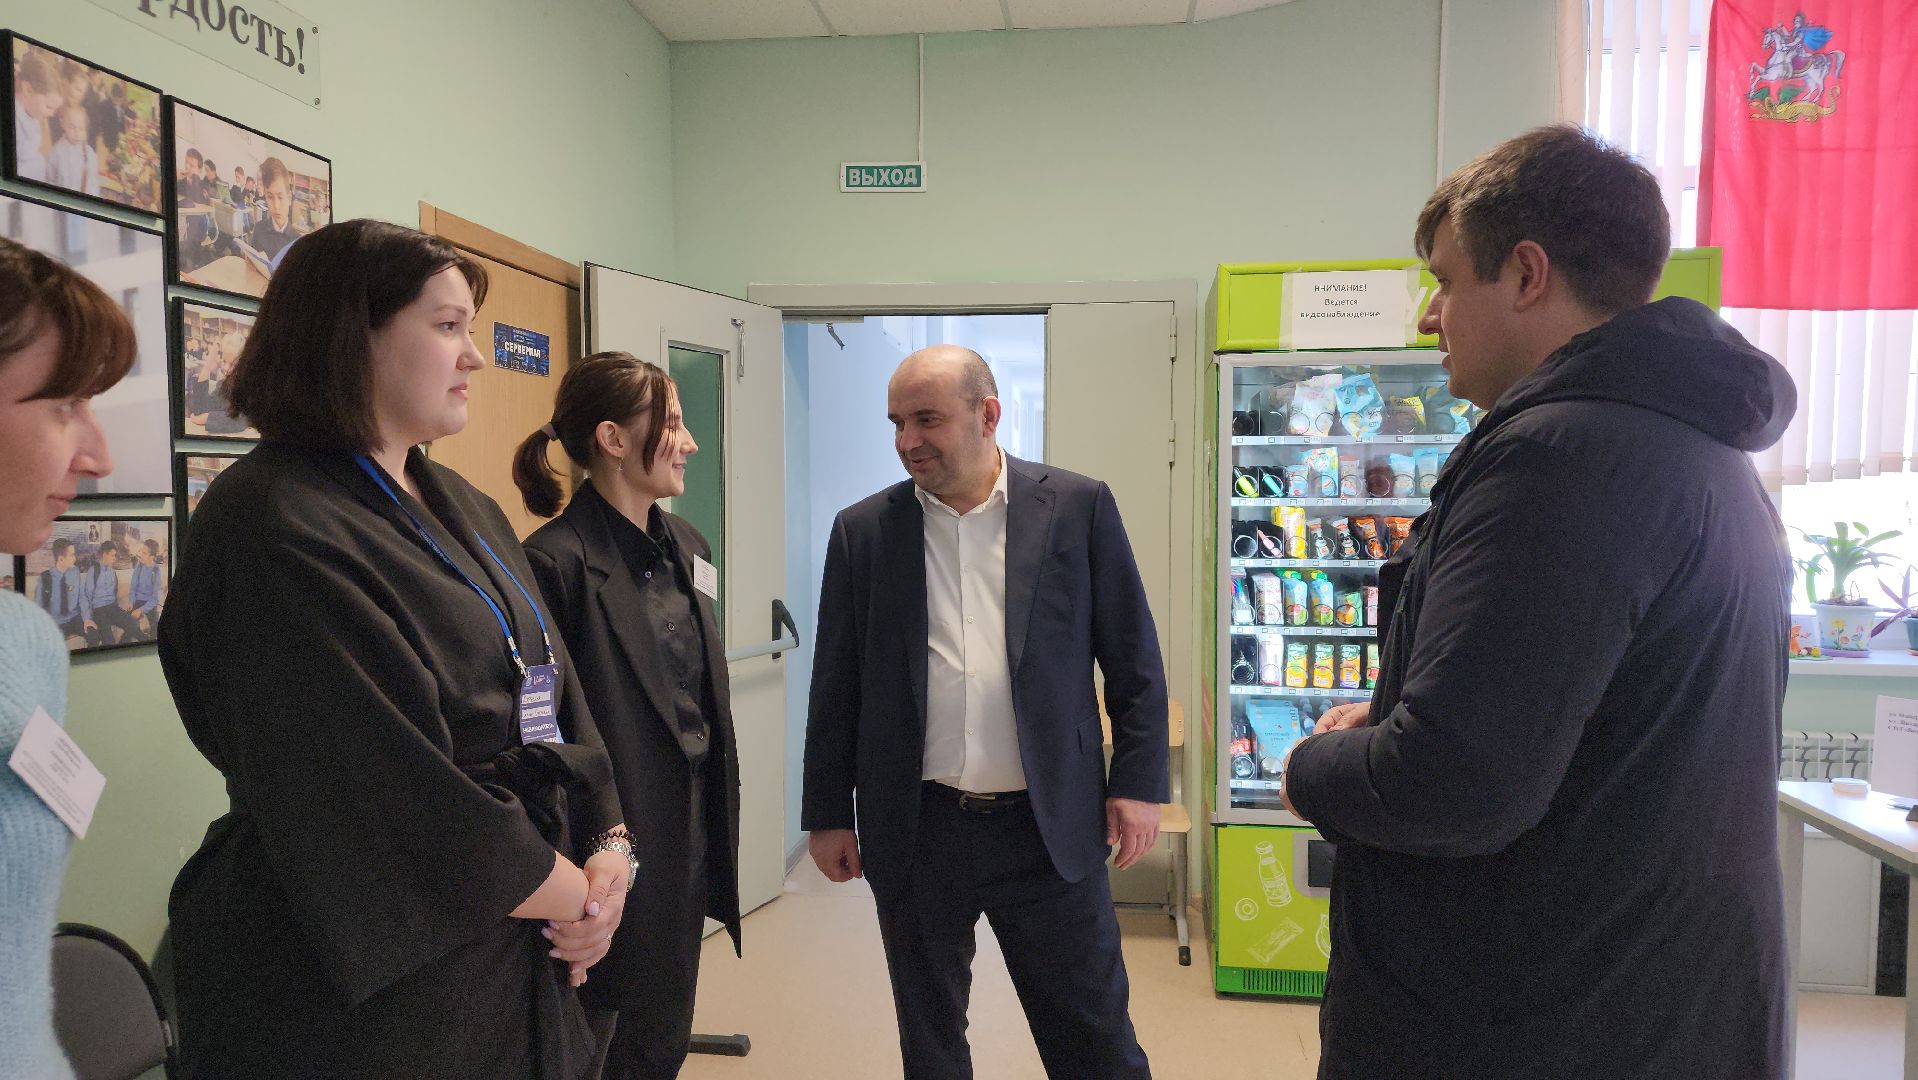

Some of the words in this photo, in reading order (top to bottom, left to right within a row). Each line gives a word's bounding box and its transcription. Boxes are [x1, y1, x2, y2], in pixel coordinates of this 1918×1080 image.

[137, 0, 305, 75] дость!
[848, 168, 918, 186] ВЫХОД
[1314, 284, 1368, 293] ВНИМАНИЕ!
[1324, 298, 1358, 307] Ведется
[1300, 311, 1381, 319] видеонаблюдение
